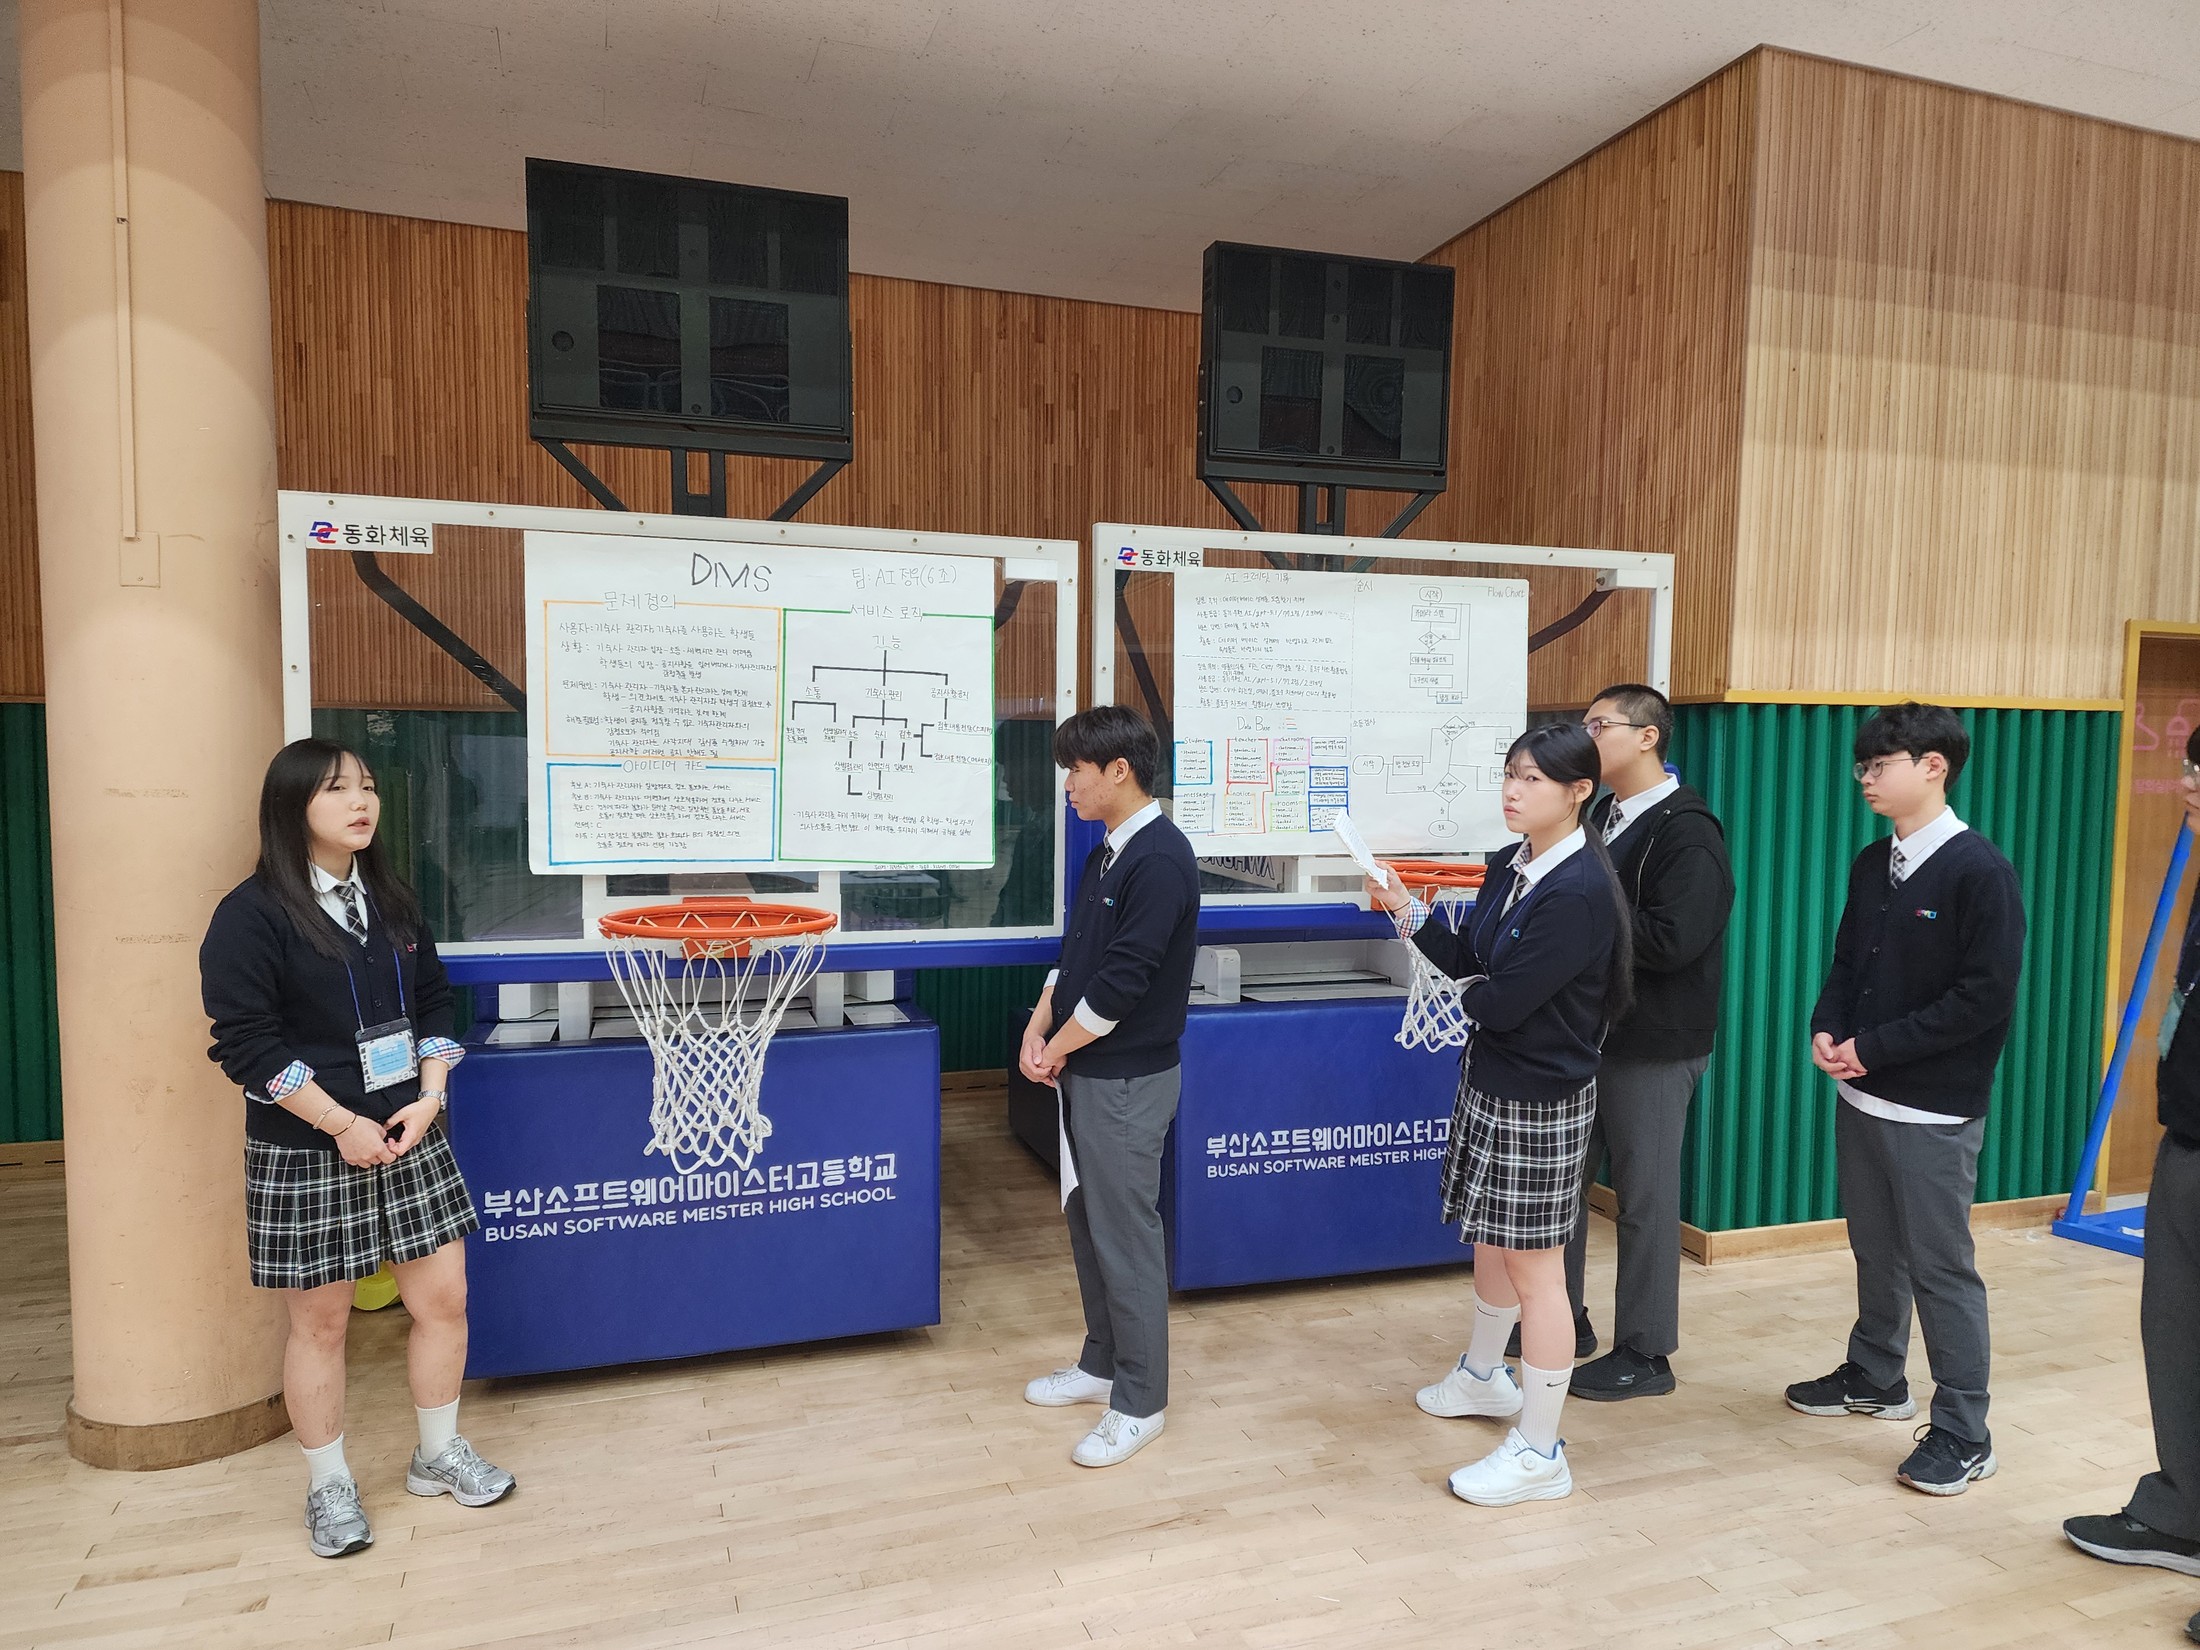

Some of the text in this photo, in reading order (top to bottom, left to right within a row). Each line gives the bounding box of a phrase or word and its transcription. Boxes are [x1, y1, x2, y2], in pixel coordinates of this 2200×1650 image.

[342, 524, 430, 548] 동화체육
[1141, 549, 1202, 567] 동화체육
[691, 552, 772, 592] DIMS
[875, 568, 896, 587] AI
[1224, 572, 1239, 583] AI
[1487, 586, 1526, 598] Flow Chart
[850, 604, 923, 622] 서비스 로직
[690, 625, 726, 638] 사용하는
[729, 627, 756, 641] 학생들
[597, 643, 623, 654] 기숙사
[865, 687, 903, 702] 기숙사 관리
[623, 759, 706, 773] 아이디어 카드
[1198, 856, 1276, 881] GHWA
[1207, 1147, 1449, 1179] BUSAN SOFTWARE MEISTER HIGH
[483, 1153, 898, 1219] 부산소프트웨어마이스터고등학교
[485, 1185, 897, 1243] BUSAN SOFTWARE MEISTER HIGH SCHOOL
